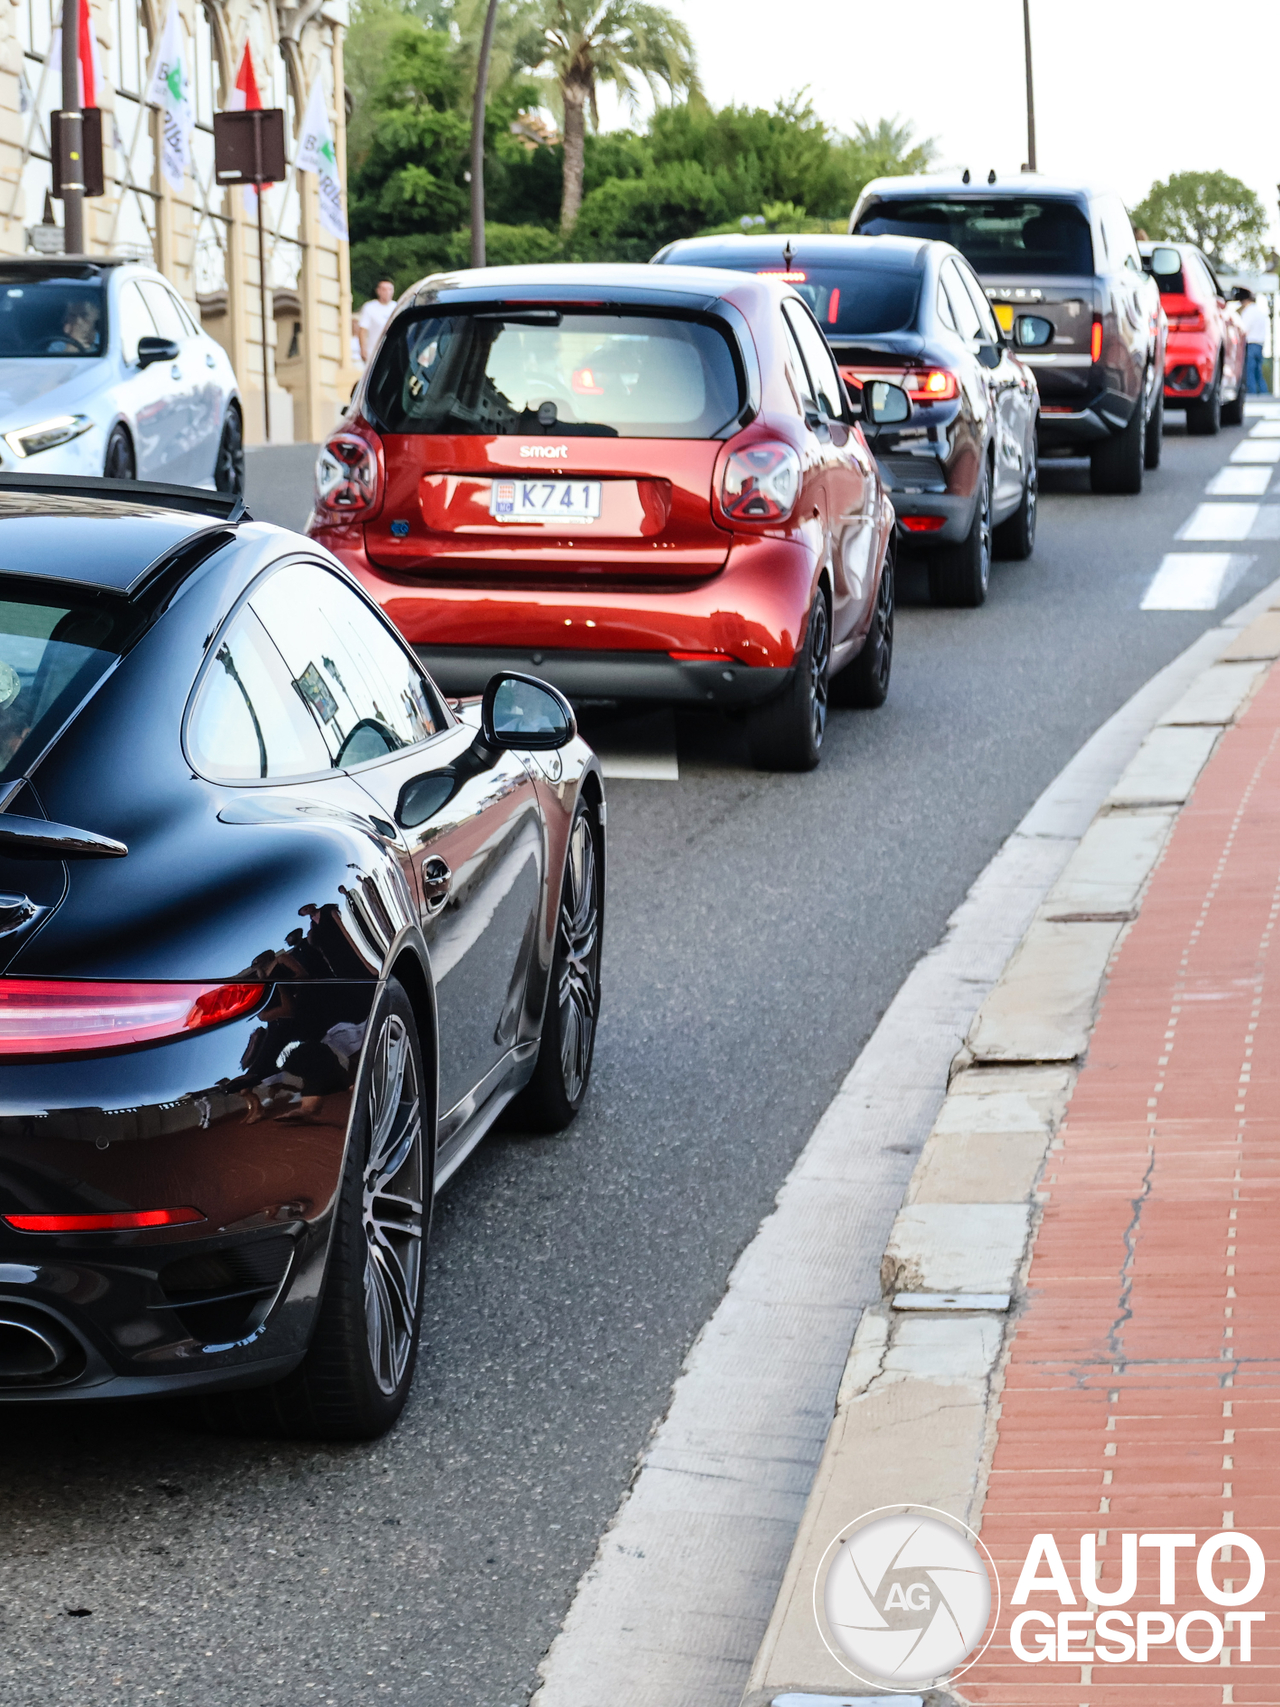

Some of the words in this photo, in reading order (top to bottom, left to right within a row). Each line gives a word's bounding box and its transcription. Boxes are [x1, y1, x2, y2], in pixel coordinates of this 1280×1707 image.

[984, 288, 1042, 298] OVER
[519, 444, 568, 459] smart
[522, 483, 591, 509] K741
